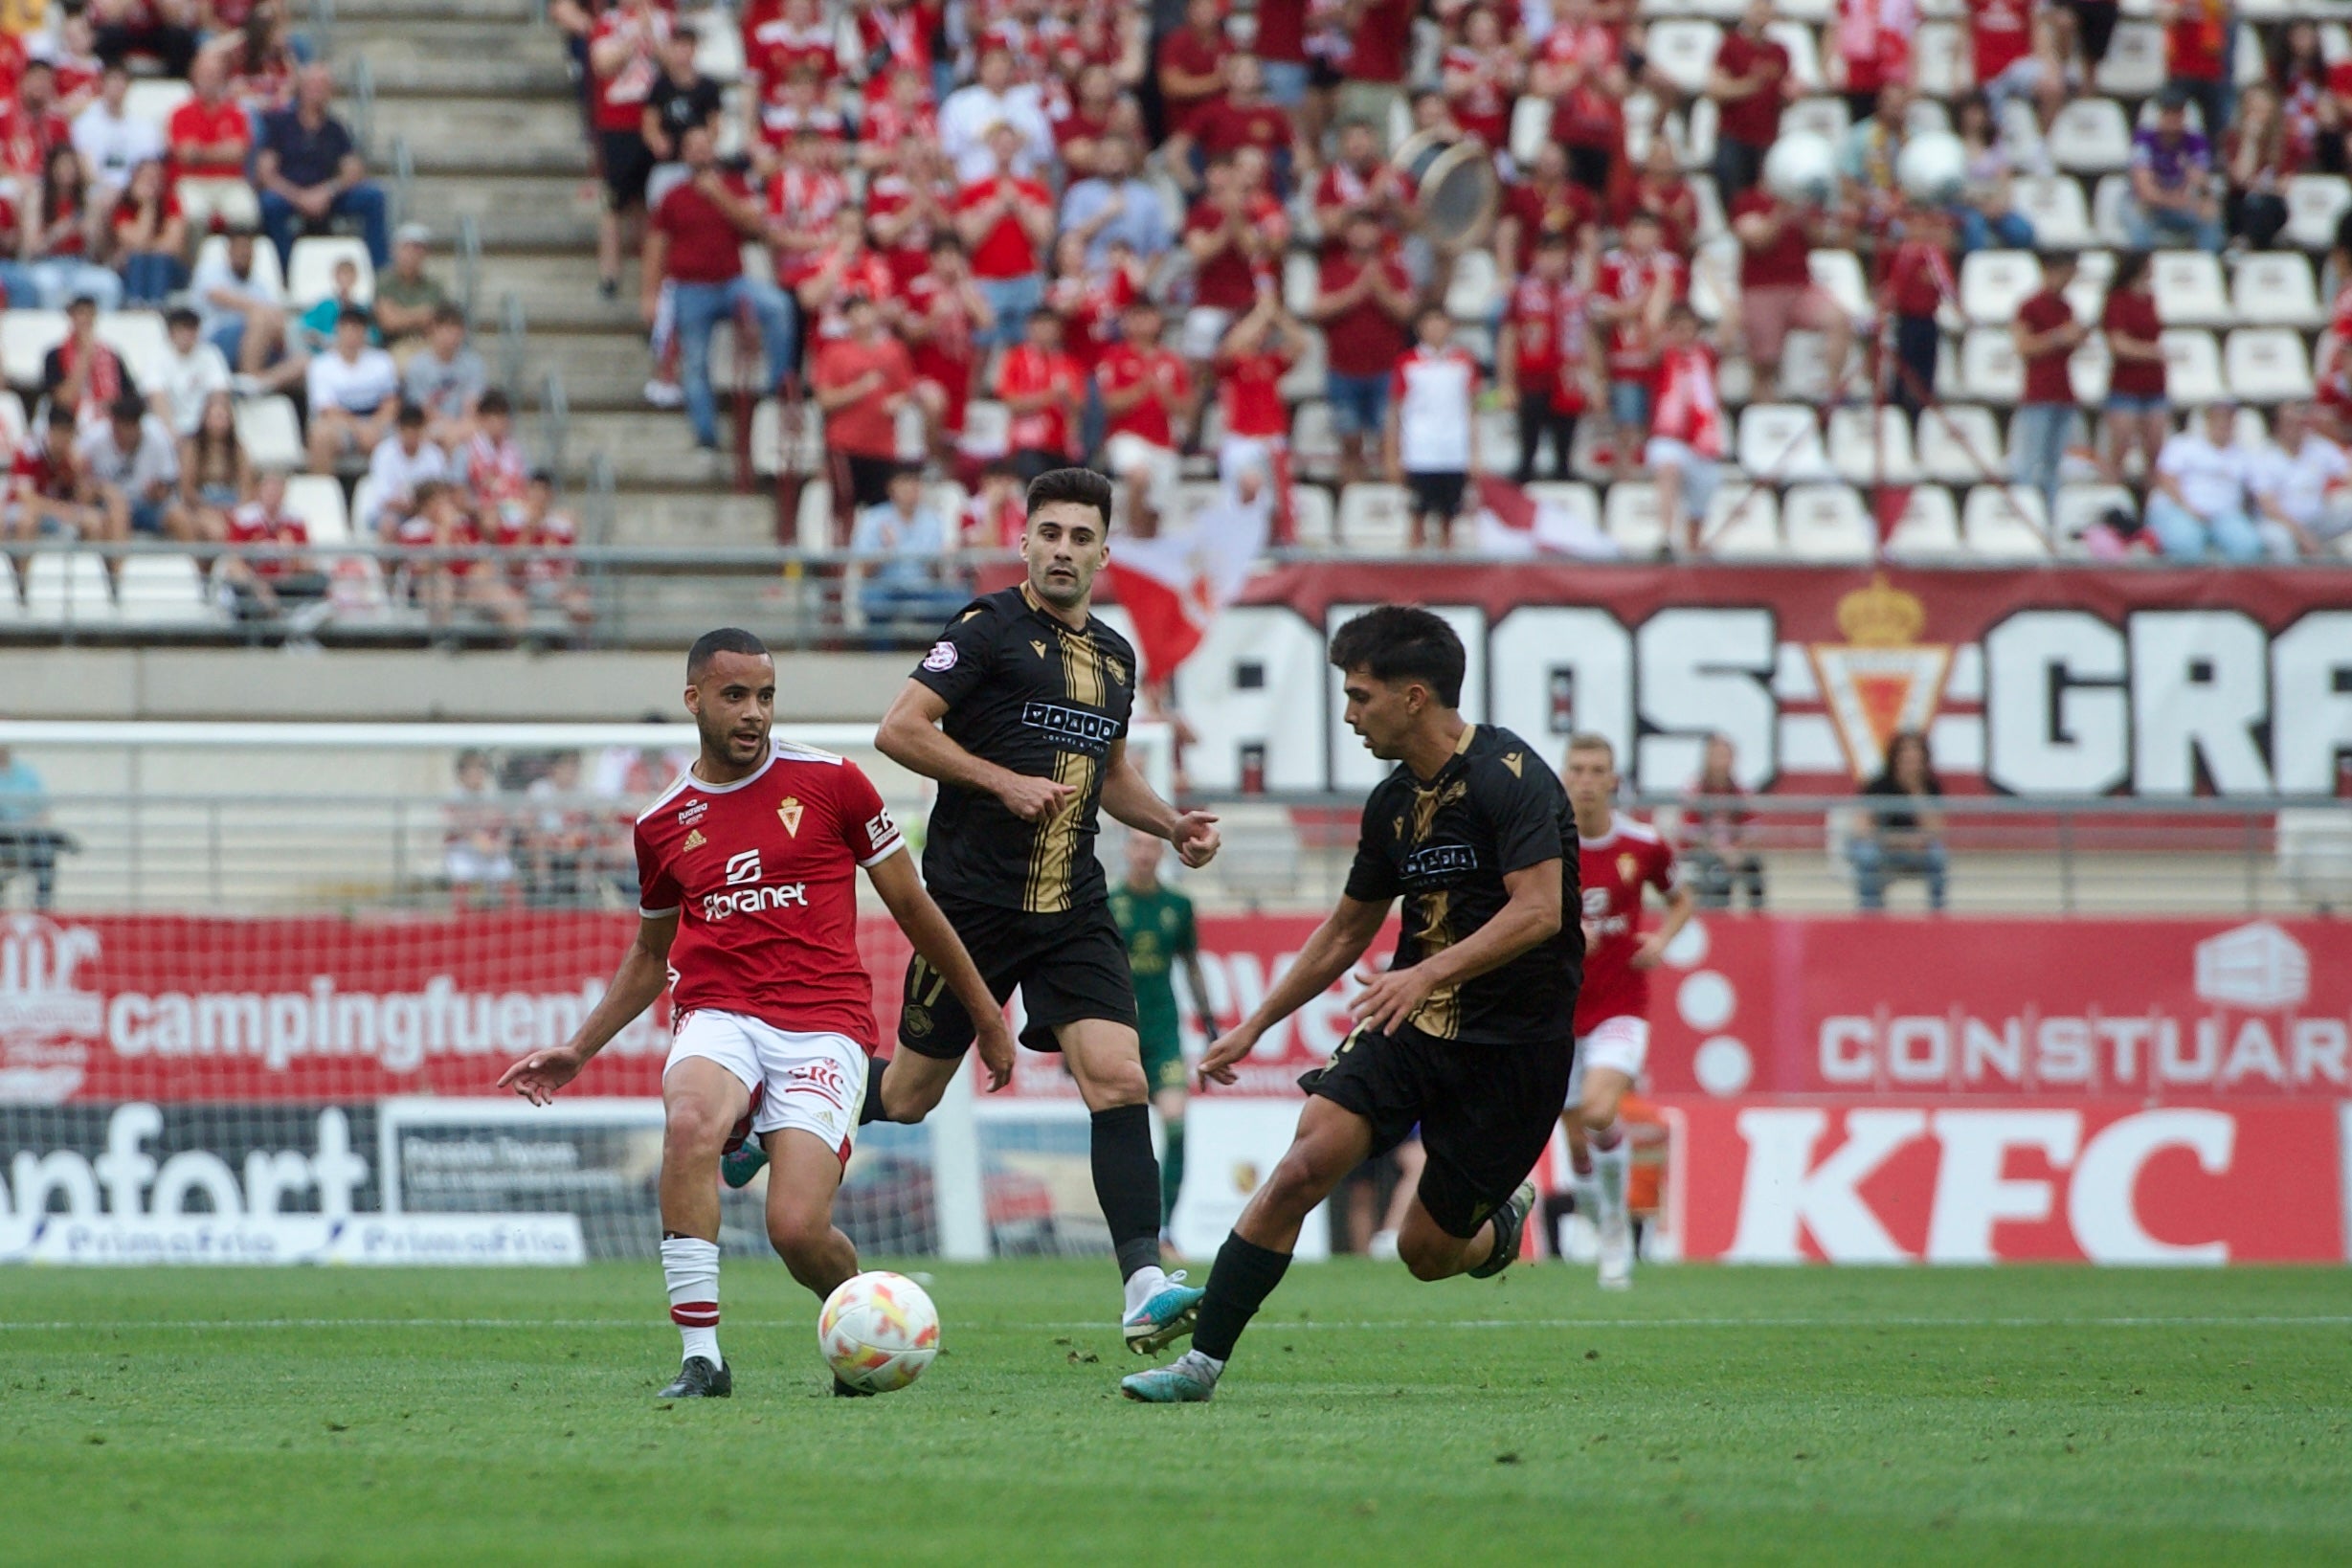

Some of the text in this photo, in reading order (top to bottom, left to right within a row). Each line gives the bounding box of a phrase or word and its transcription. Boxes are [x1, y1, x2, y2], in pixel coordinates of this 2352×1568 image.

[1820, 1015, 2349, 1084] CONSTUAR
[0, 1101, 370, 1216] nfort
[1718, 1106, 2237, 1266] KFC
